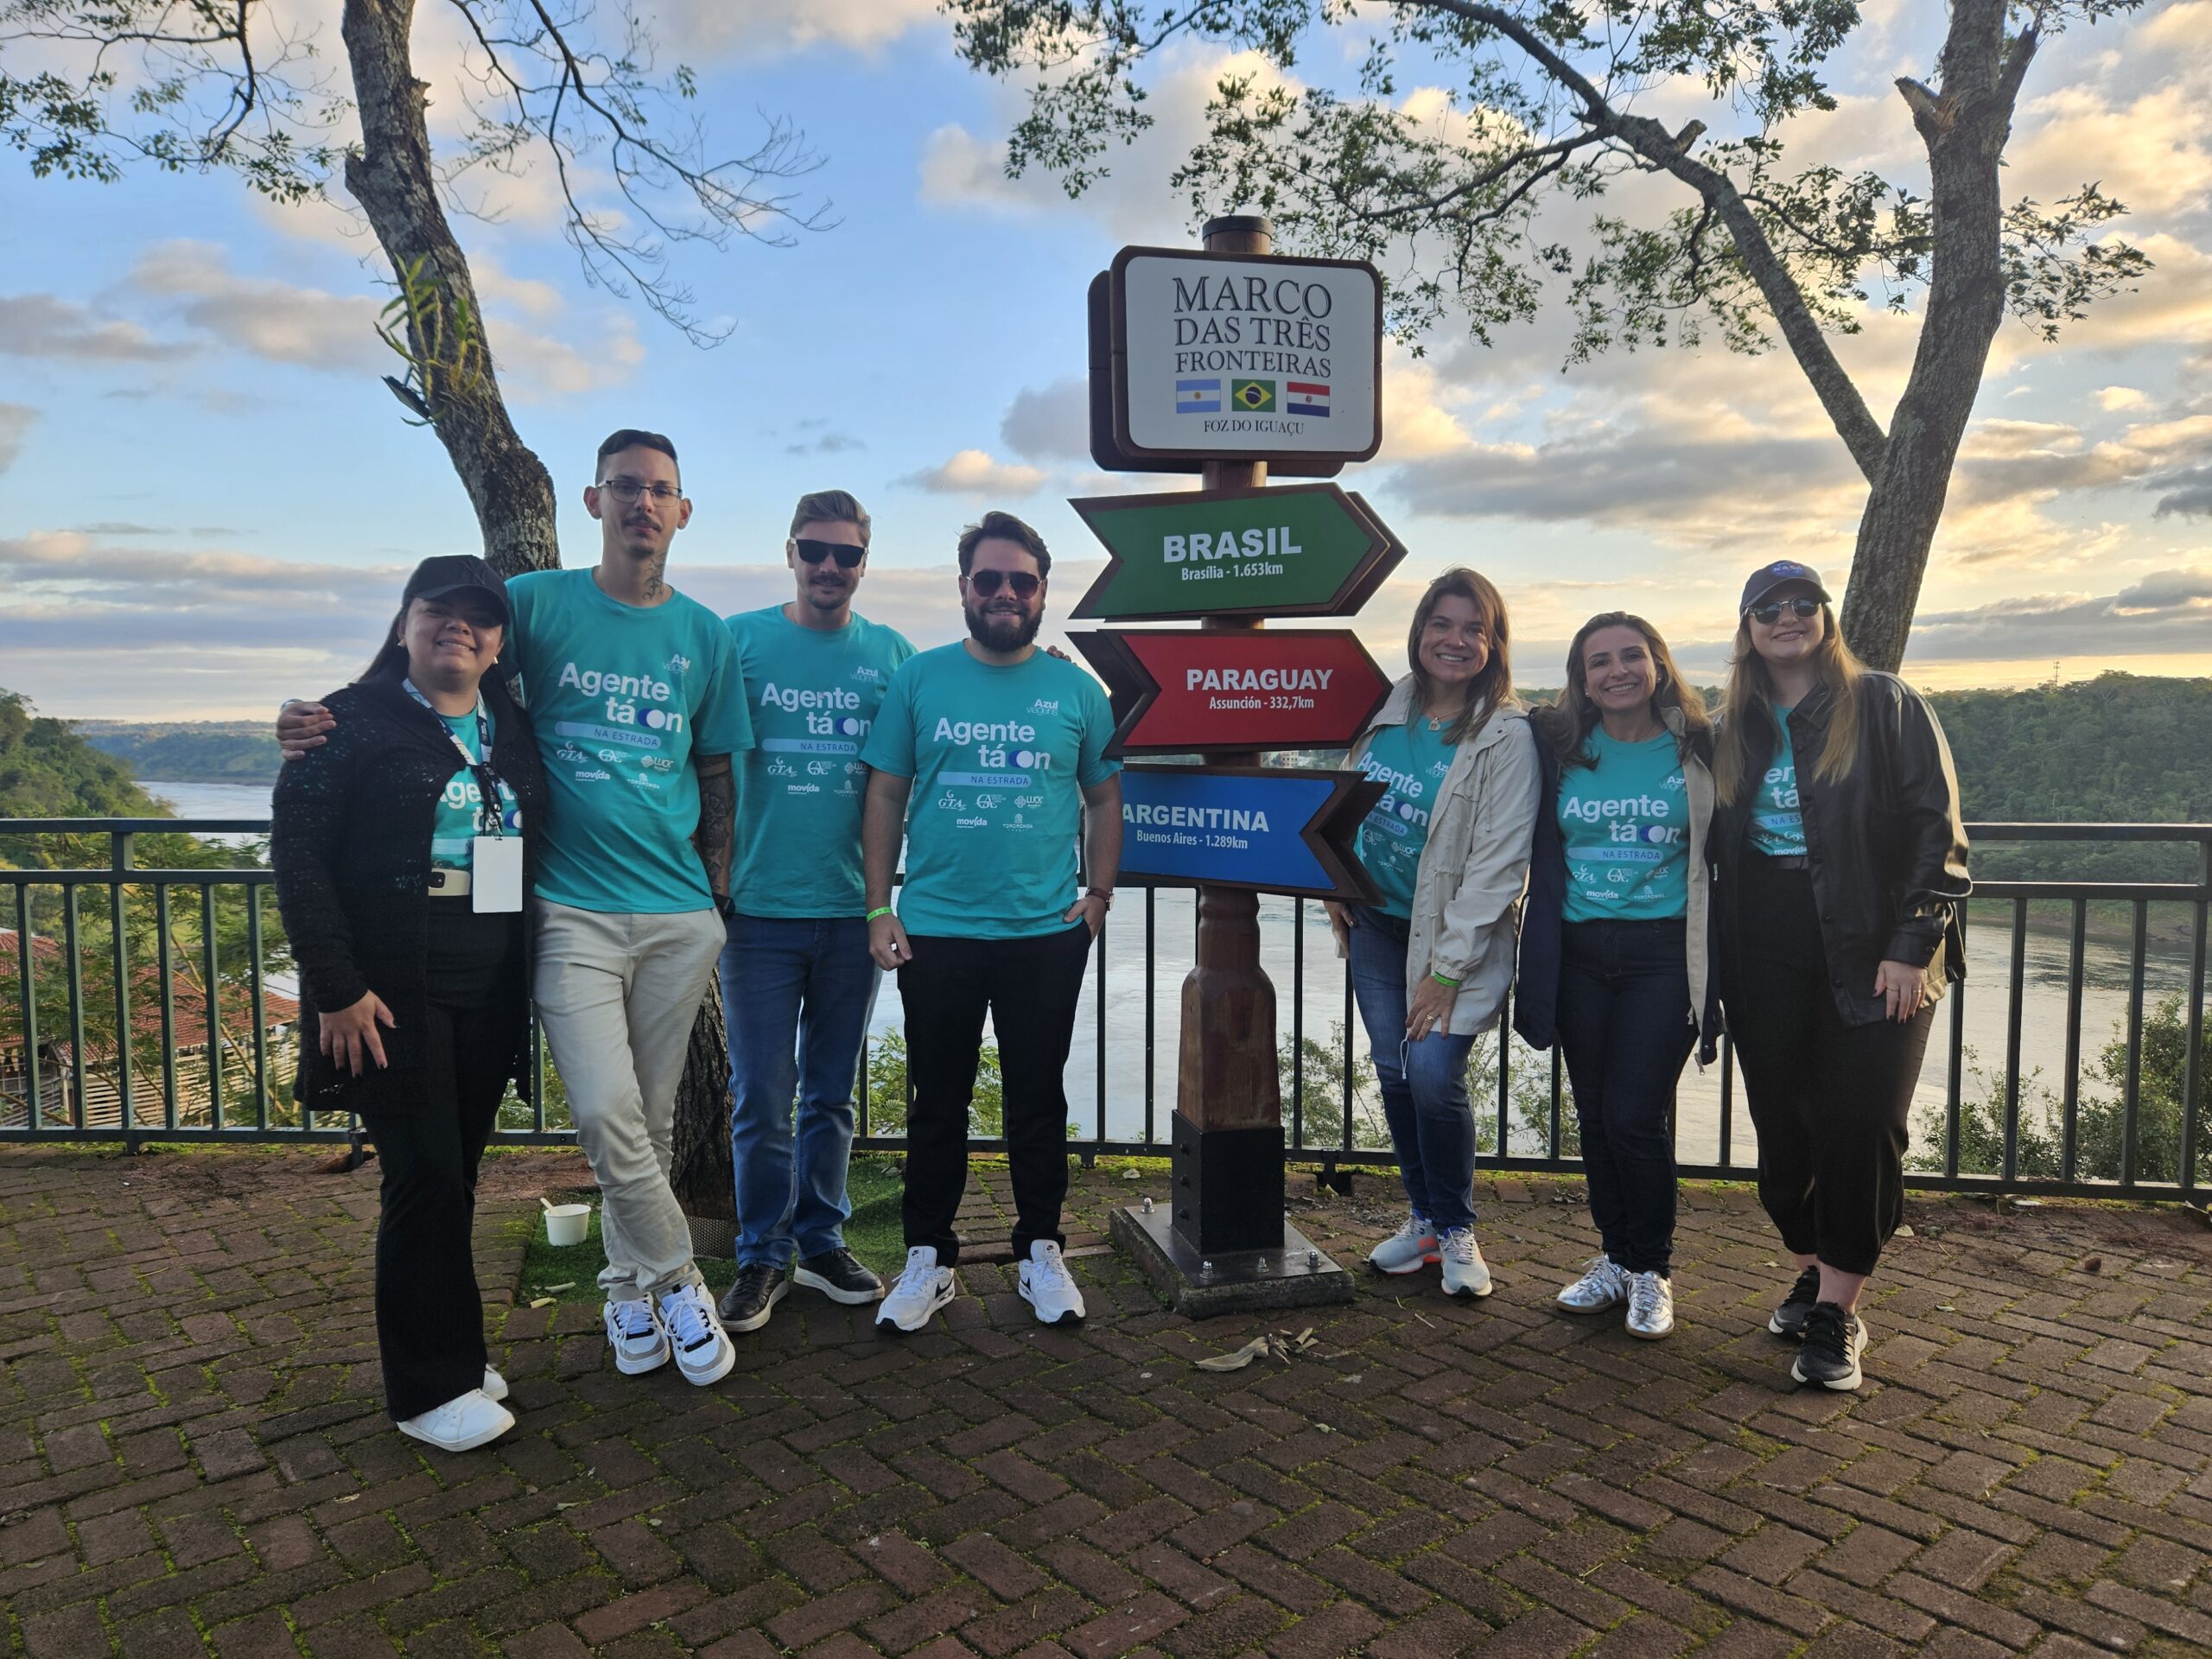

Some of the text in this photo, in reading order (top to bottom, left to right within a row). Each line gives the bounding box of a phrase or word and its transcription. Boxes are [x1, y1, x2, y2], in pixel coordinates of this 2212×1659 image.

[1173, 276, 1332, 319] MARCO
[1174, 317, 1331, 352] DAS TRÊS
[1175, 350, 1332, 378] FRONTEIRAS
[1204, 420, 1304, 436] FOZ DO IGUAÇU
[1163, 526, 1302, 563] BRASIL
[1181, 566, 1224, 581] Brasília
[1233, 563, 1283, 578] 1.653km
[558, 662, 671, 702] Agente
[856, 666, 879, 677] Azul
[1186, 669, 1333, 691] PARAGUAY
[760, 683, 861, 713] Agente
[1034, 698, 1058, 709] Azul
[1209, 696, 1262, 709] Assunción
[1269, 696, 1314, 711] 332,7km
[594, 728, 658, 747] NA ESTRADA
[933, 717, 1036, 746] Agente
[817, 743, 855, 752] ESTRADA
[971, 775, 1029, 785] NA ESTRADA
[1357, 751, 1423, 798] Agente
[1122, 803, 1269, 832] ARGENTINA
[1562, 794, 1669, 823] Agente
[1375, 816, 1405, 835] ESTRADA
[1136, 830, 1172, 845] Buenos
[1173, 833, 1197, 846] Aires
[1205, 835, 1249, 849] 1.289km
